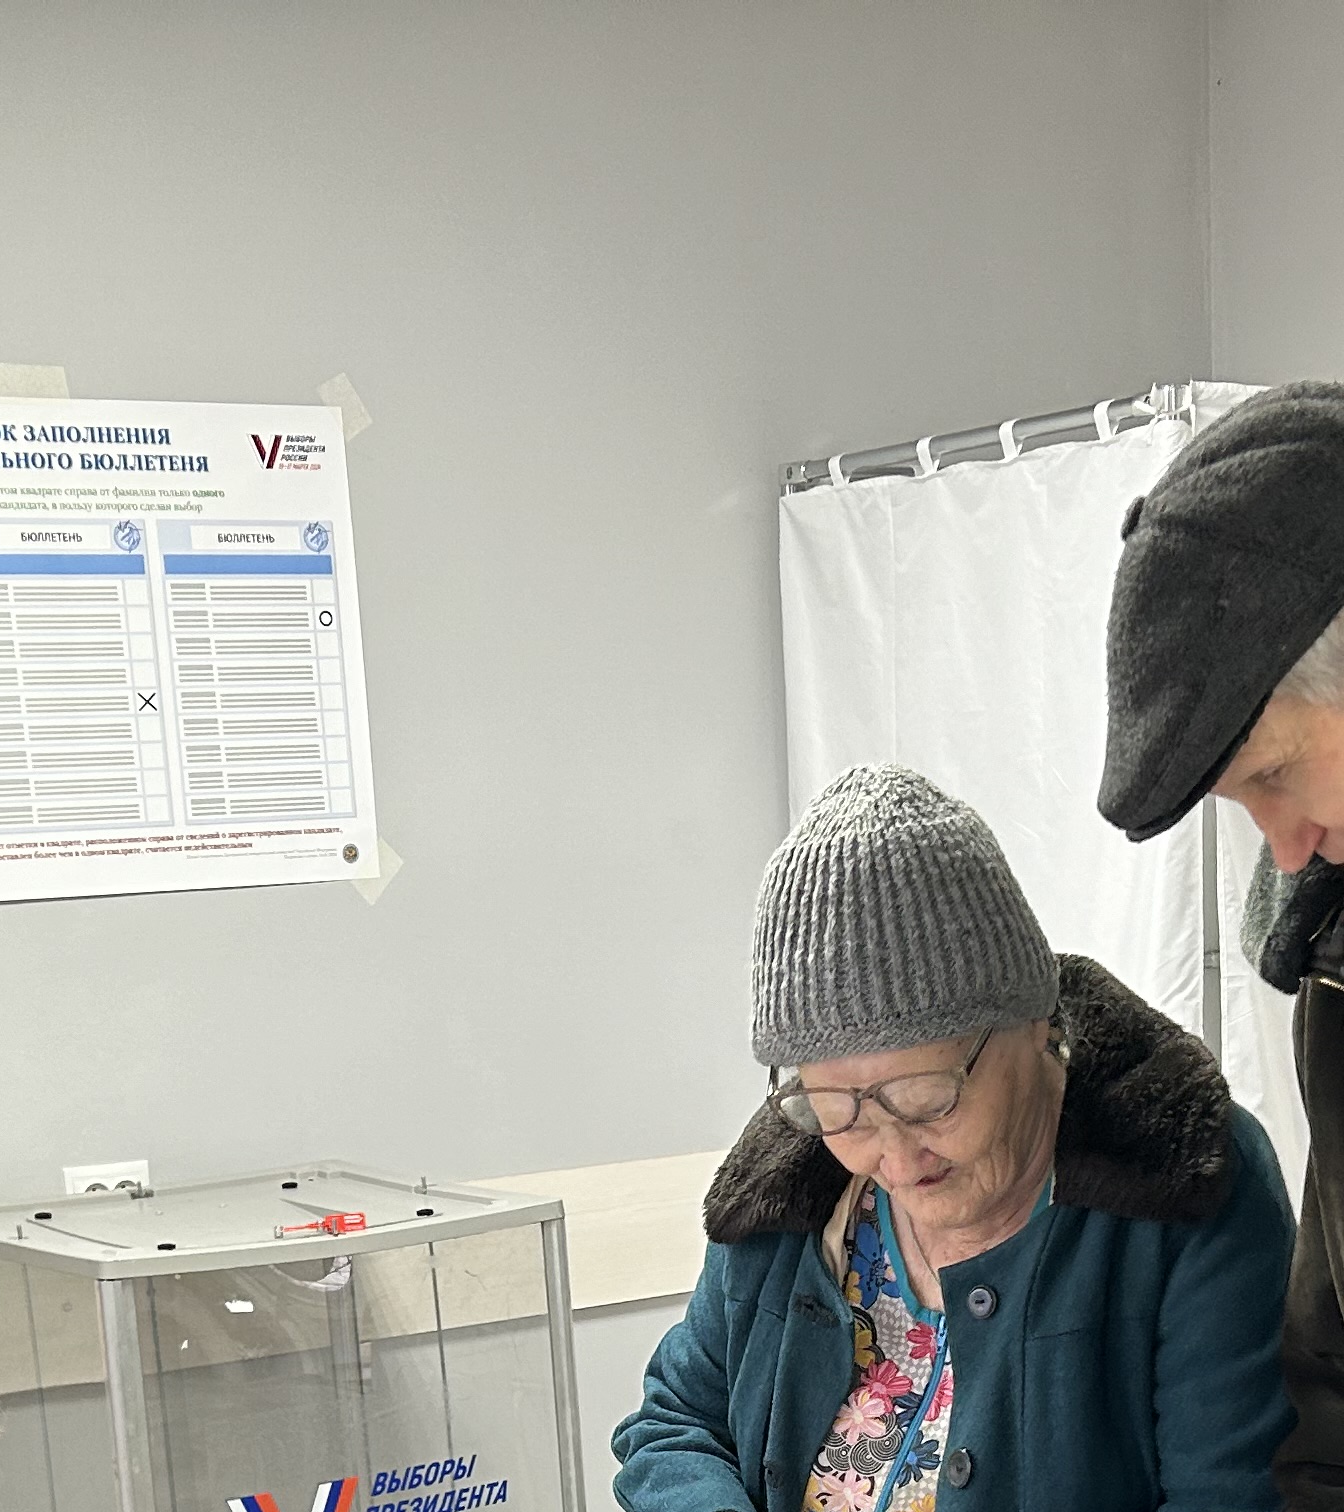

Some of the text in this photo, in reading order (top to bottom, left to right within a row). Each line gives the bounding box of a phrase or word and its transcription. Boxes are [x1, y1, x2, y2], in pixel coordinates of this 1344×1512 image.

[23, 425, 172, 445] ЗАПОЛНЕНИЯ
[80, 453, 210, 472] БЮЛЛЕТЕНЯ
[21, 532, 83, 543] БЮЛЛЕТЕНЬ
[217, 533, 276, 544] БЮЛЛЕТЕНЬ
[371, 1454, 477, 1497] ВЫБОРЫ
